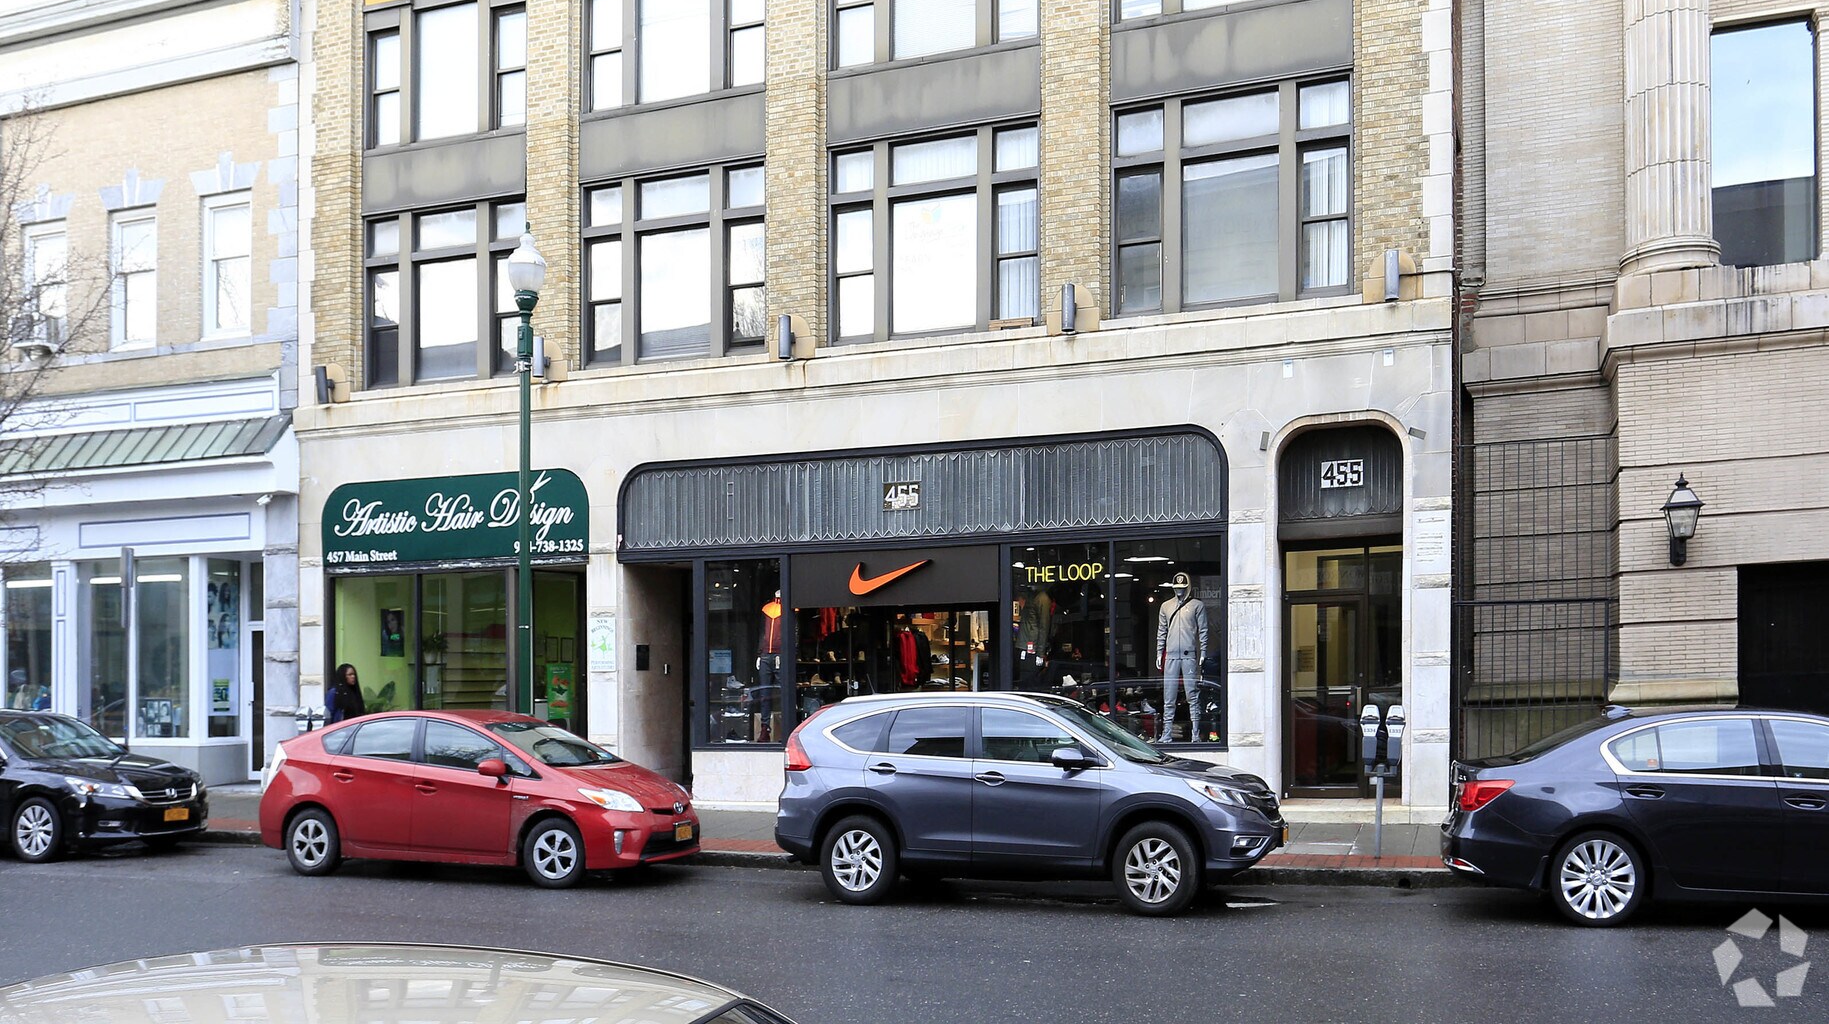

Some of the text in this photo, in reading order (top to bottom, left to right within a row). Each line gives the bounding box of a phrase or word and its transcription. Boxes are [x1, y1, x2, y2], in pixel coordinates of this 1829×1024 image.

[1322, 461, 1362, 486] 455
[884, 484, 919, 508] 455
[334, 488, 574, 541] Artistic Hair Dsign
[326, 549, 398, 563] 457 Main Street
[513, 539, 584, 554] 9-738-1325
[1024, 562, 1103, 583] THE LOOP
